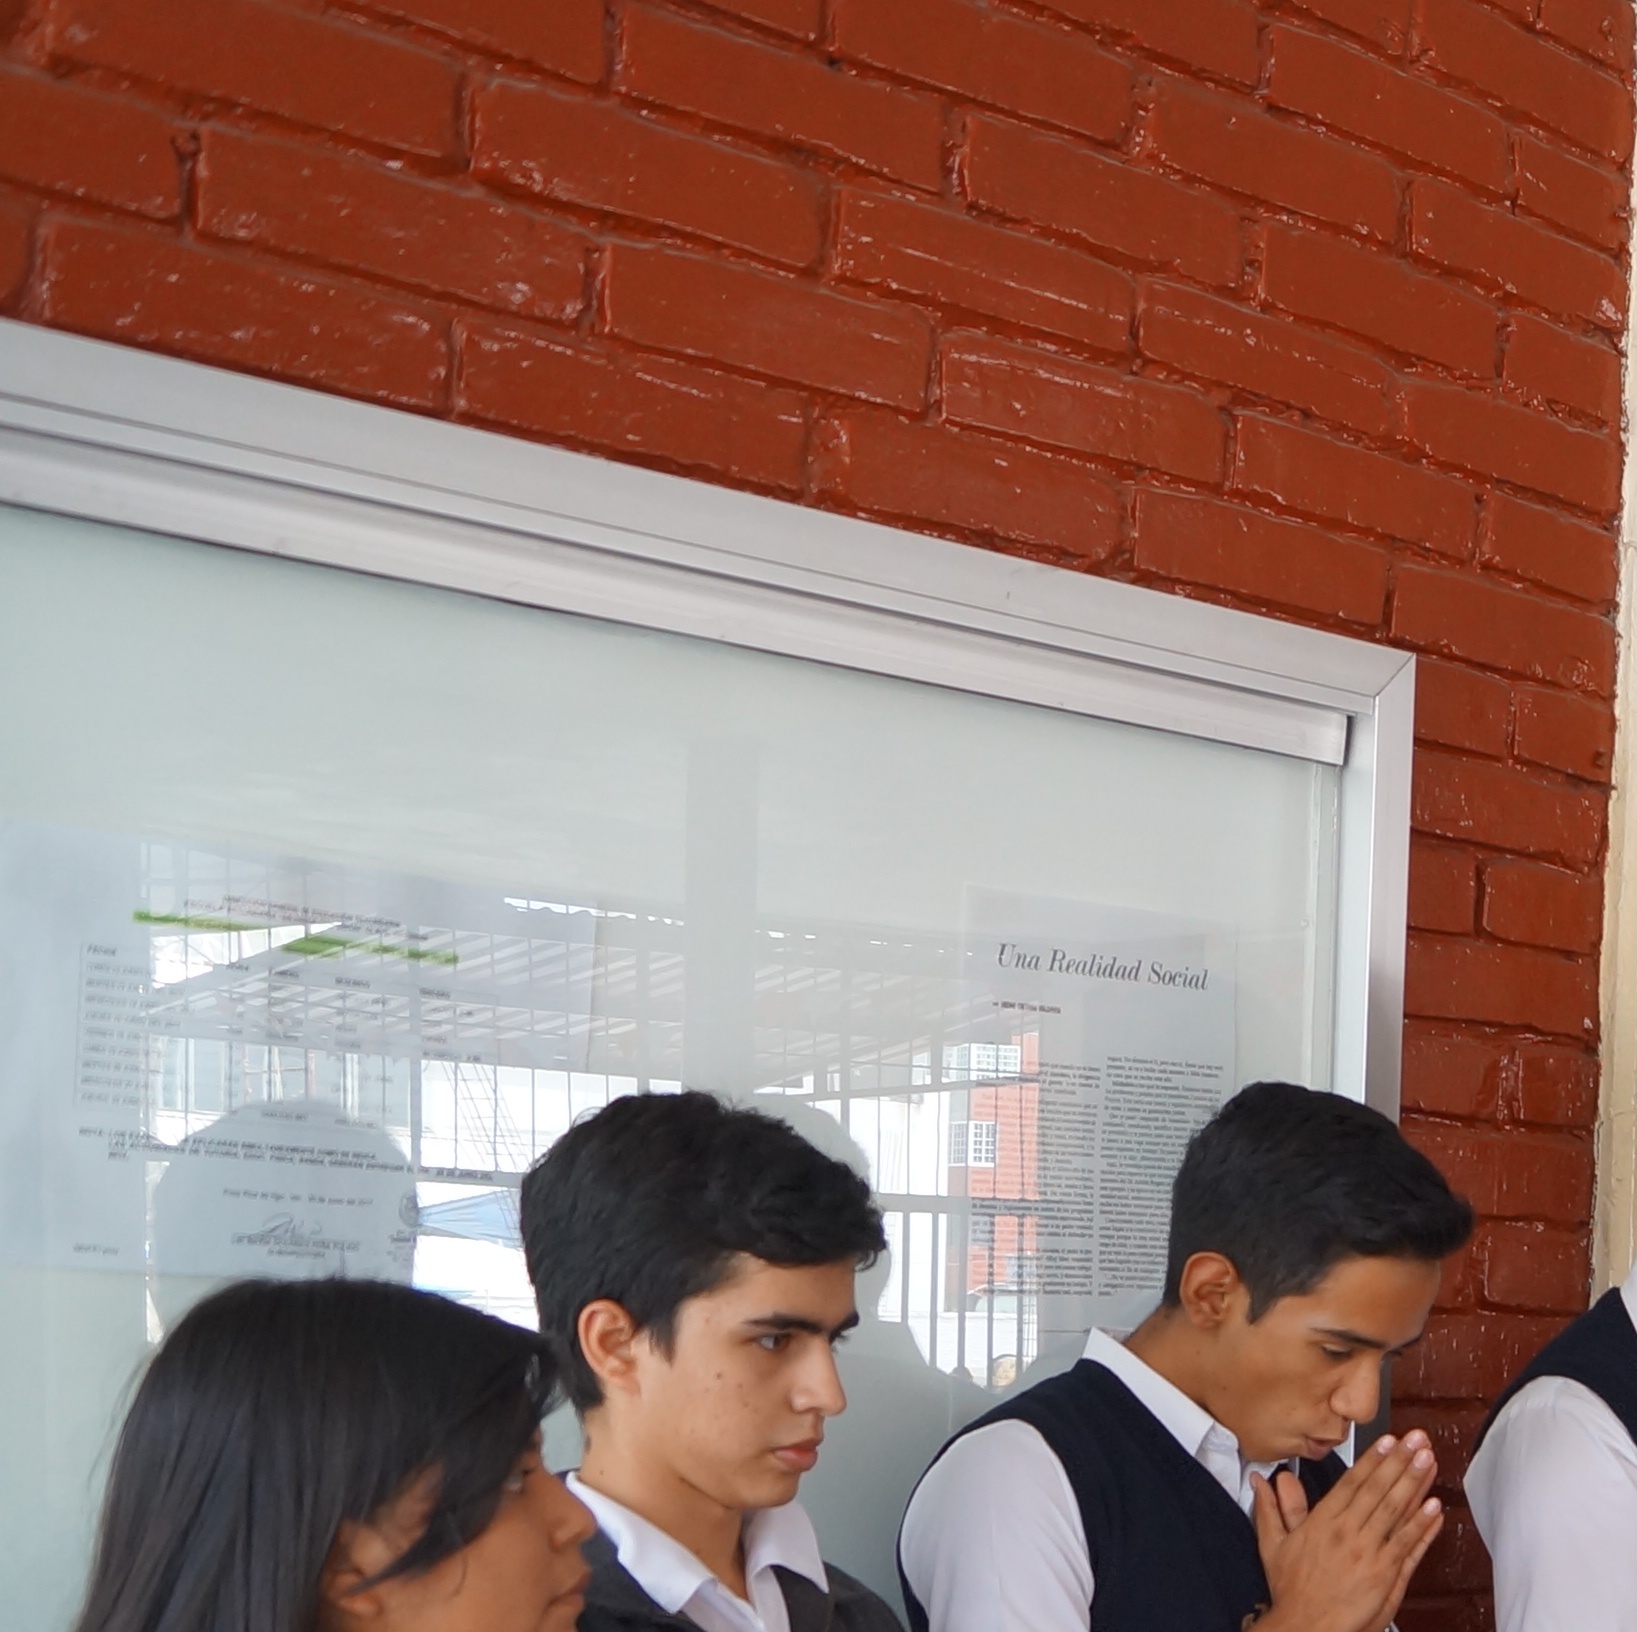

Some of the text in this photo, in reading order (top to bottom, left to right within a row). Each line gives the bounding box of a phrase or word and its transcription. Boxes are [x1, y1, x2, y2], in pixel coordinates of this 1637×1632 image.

[998, 942, 1209, 991] Una Realidad Social
